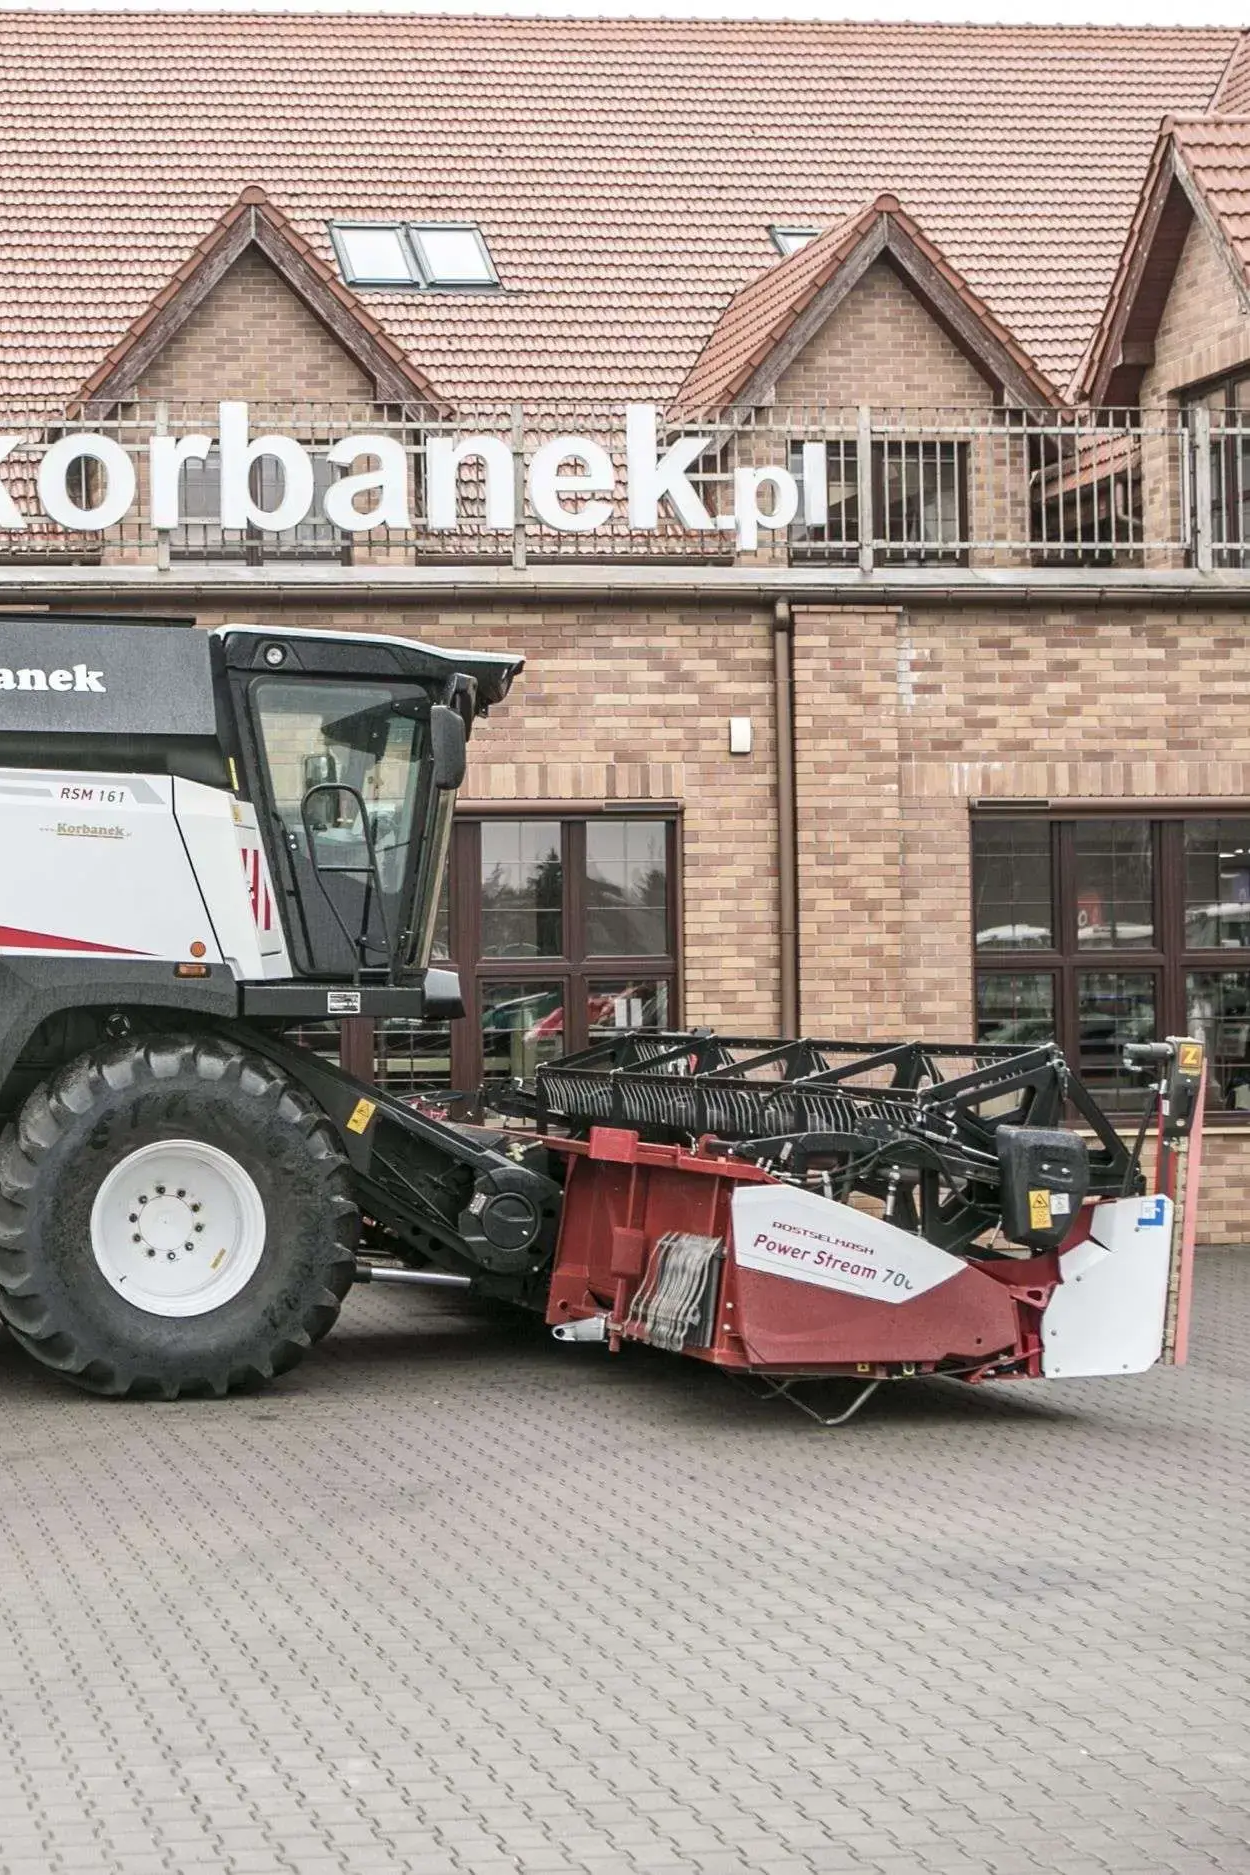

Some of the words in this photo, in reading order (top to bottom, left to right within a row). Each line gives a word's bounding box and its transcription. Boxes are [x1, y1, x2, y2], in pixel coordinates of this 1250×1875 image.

[60, 787, 93, 801] RSM
[99, 790, 125, 803] 161
[772, 1221, 875, 1256] ROSTSELMASH
[753, 1233, 811, 1262] Power
[813, 1250, 878, 1280] Stream
